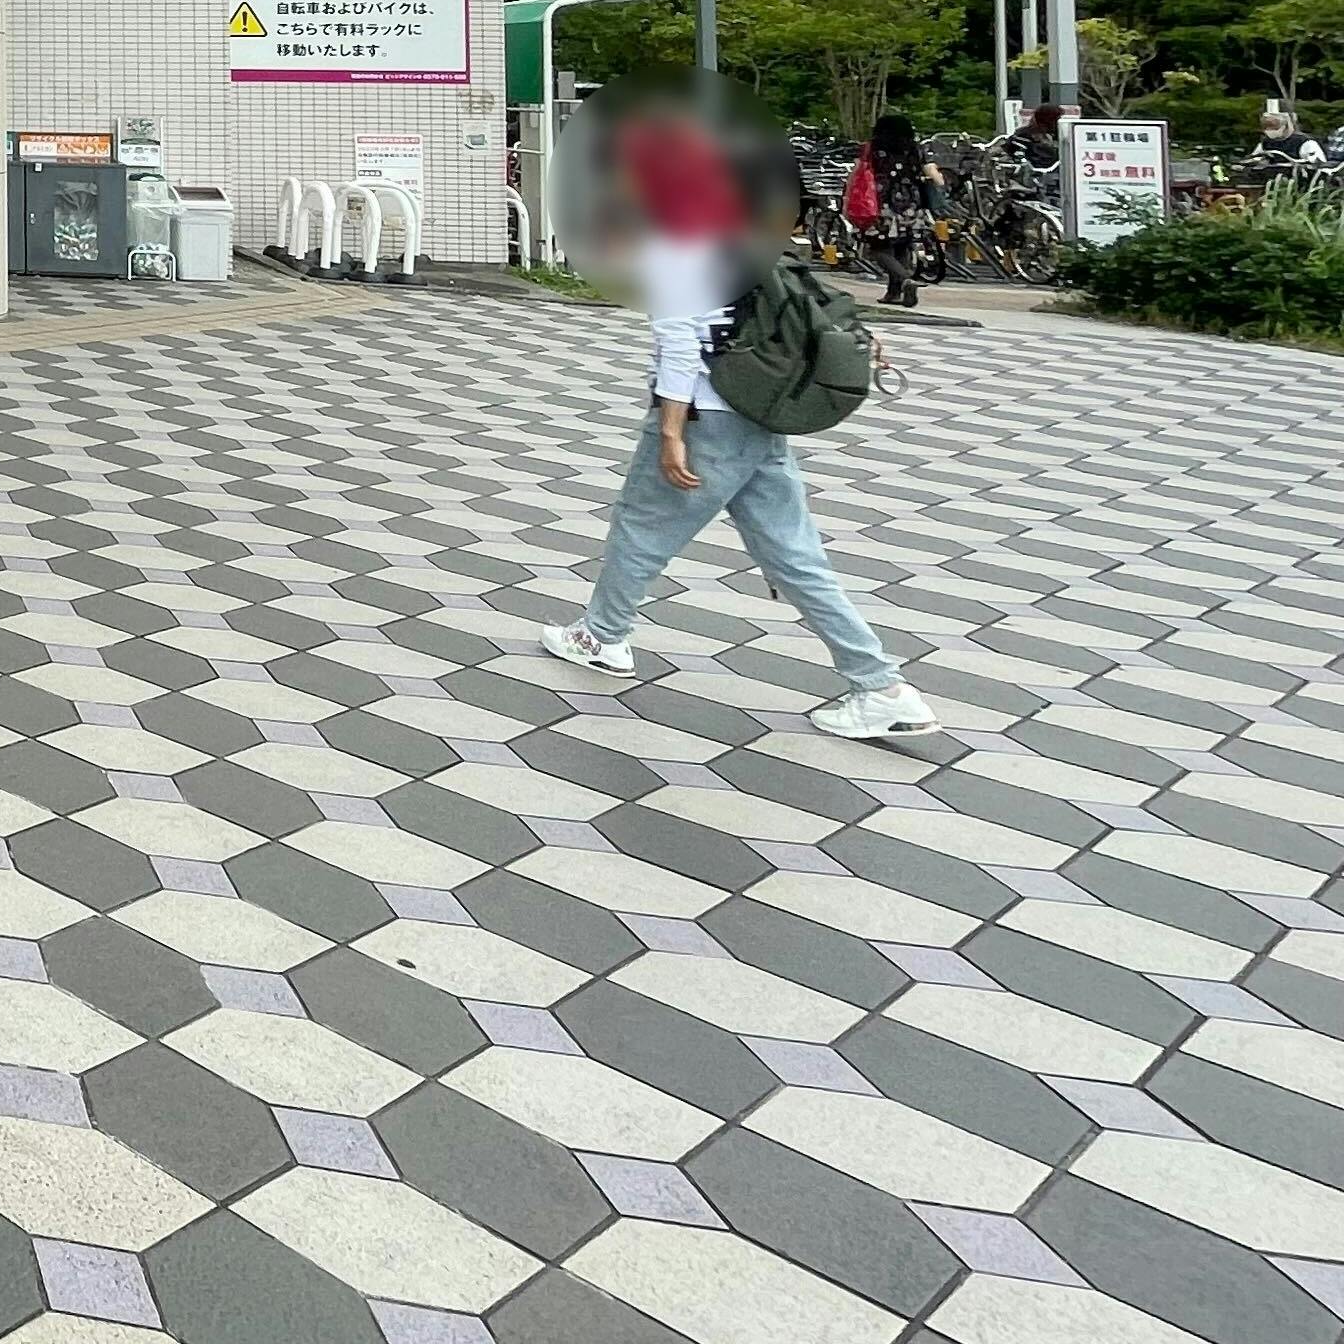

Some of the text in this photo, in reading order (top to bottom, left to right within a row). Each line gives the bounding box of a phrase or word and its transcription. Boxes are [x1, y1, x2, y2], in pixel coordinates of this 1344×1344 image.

[276, 2, 435, 16] 自転車およびバイクは、
[276, 23, 423, 37] こちらで有料ラックに
[276, 43, 389, 58] 移動いたします。
